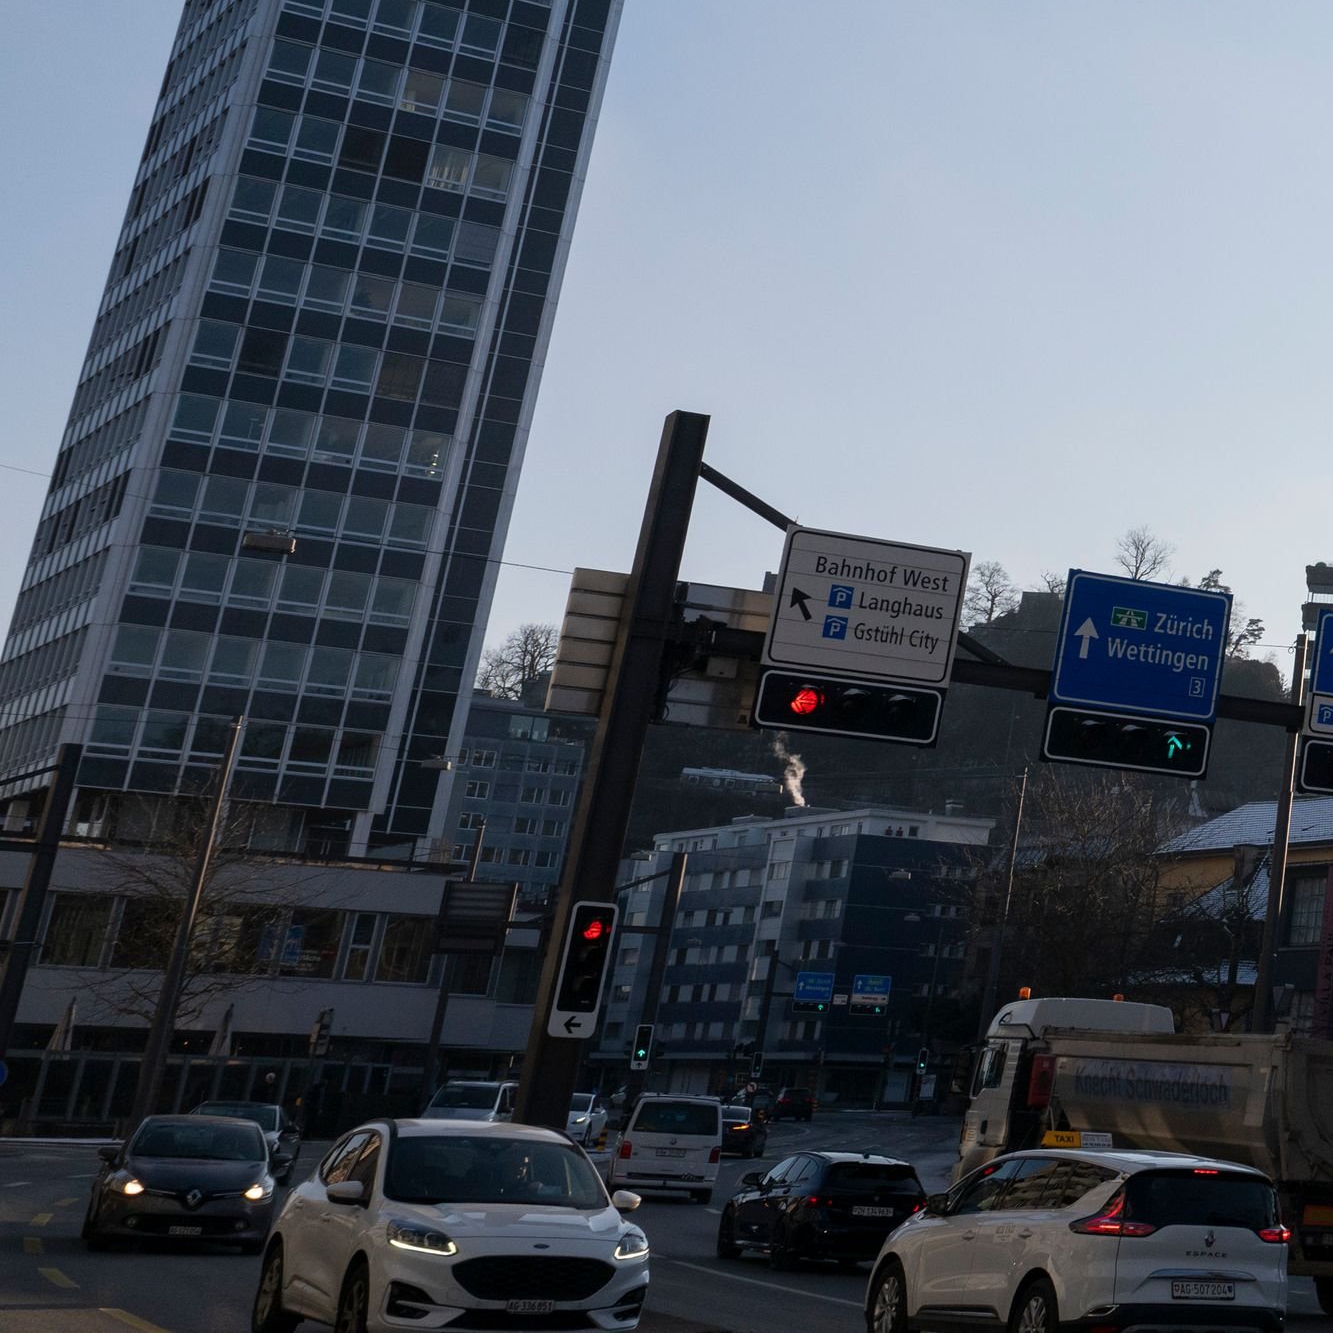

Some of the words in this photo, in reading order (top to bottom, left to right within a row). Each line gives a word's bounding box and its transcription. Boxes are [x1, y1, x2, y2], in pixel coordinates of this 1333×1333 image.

[816, 556, 897, 584] Bahnhof
[903, 568, 950, 592] West
[859, 592, 943, 619] Langhaus
[854, 622, 905, 646] Gstühl
[909, 630, 939, 654] City
[1154, 612, 1213, 641] Zürich
[1107, 637, 1209, 673] Wettingen
[1192, 680, 1201, 694] 3
[1074, 1066, 1121, 1097] Knecht
[1054, 1134, 1074, 1143] TAXI
[1185, 1250, 1228, 1258] ESPACE
